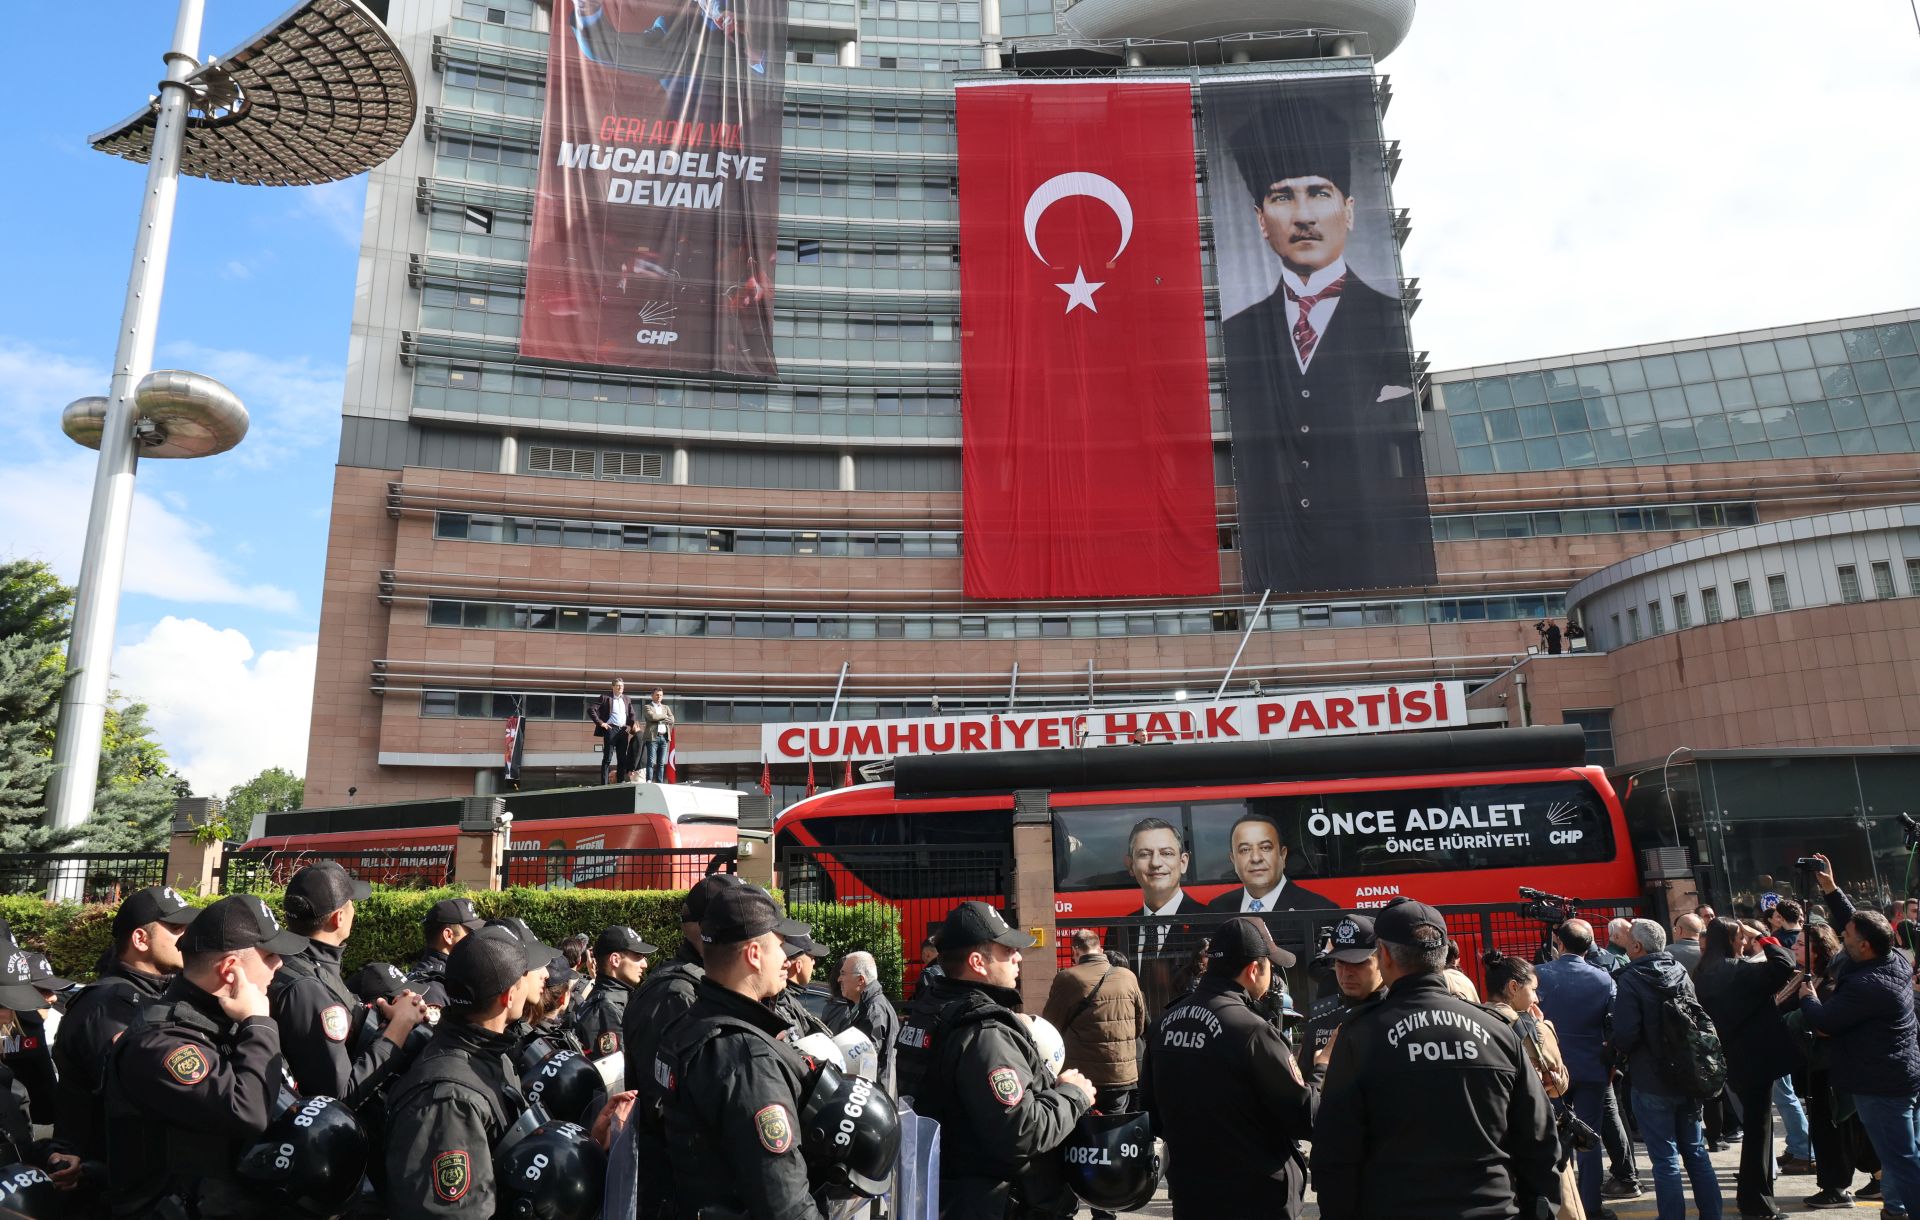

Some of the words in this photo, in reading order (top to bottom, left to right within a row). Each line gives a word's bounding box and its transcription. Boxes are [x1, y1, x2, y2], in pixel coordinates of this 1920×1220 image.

[557, 142, 766, 181] MÜCADELEYE
[607, 178, 723, 208] DEVAM
[636, 329, 678, 345] CHP
[778, 714, 1087, 757] CUMHURİYET
[1257, 682, 1448, 734] PARTİSİ
[1307, 808, 1396, 837] ÖNCE
[1405, 804, 1526, 832] ADALET
[1386, 837, 1435, 853] ÖNCE
[1439, 832, 1531, 850] HÜRRİYET!
[1549, 830, 1583, 844] CHP
[1356, 885, 1400, 897] ADNAN
[1356, 900, 1391, 908] BEKE
[1055, 901, 1073, 912] ÜR
[1188, 1005, 1223, 1038] KUVVET
[1431, 1010, 1491, 1045] KUVVET
[528, 1081, 545, 1103] 06
[835, 1119, 855, 1146] 06
[275, 1143, 294, 1169] 06
[1120, 1143, 1138, 1158] 06
[525, 1153, 549, 1181] 06
